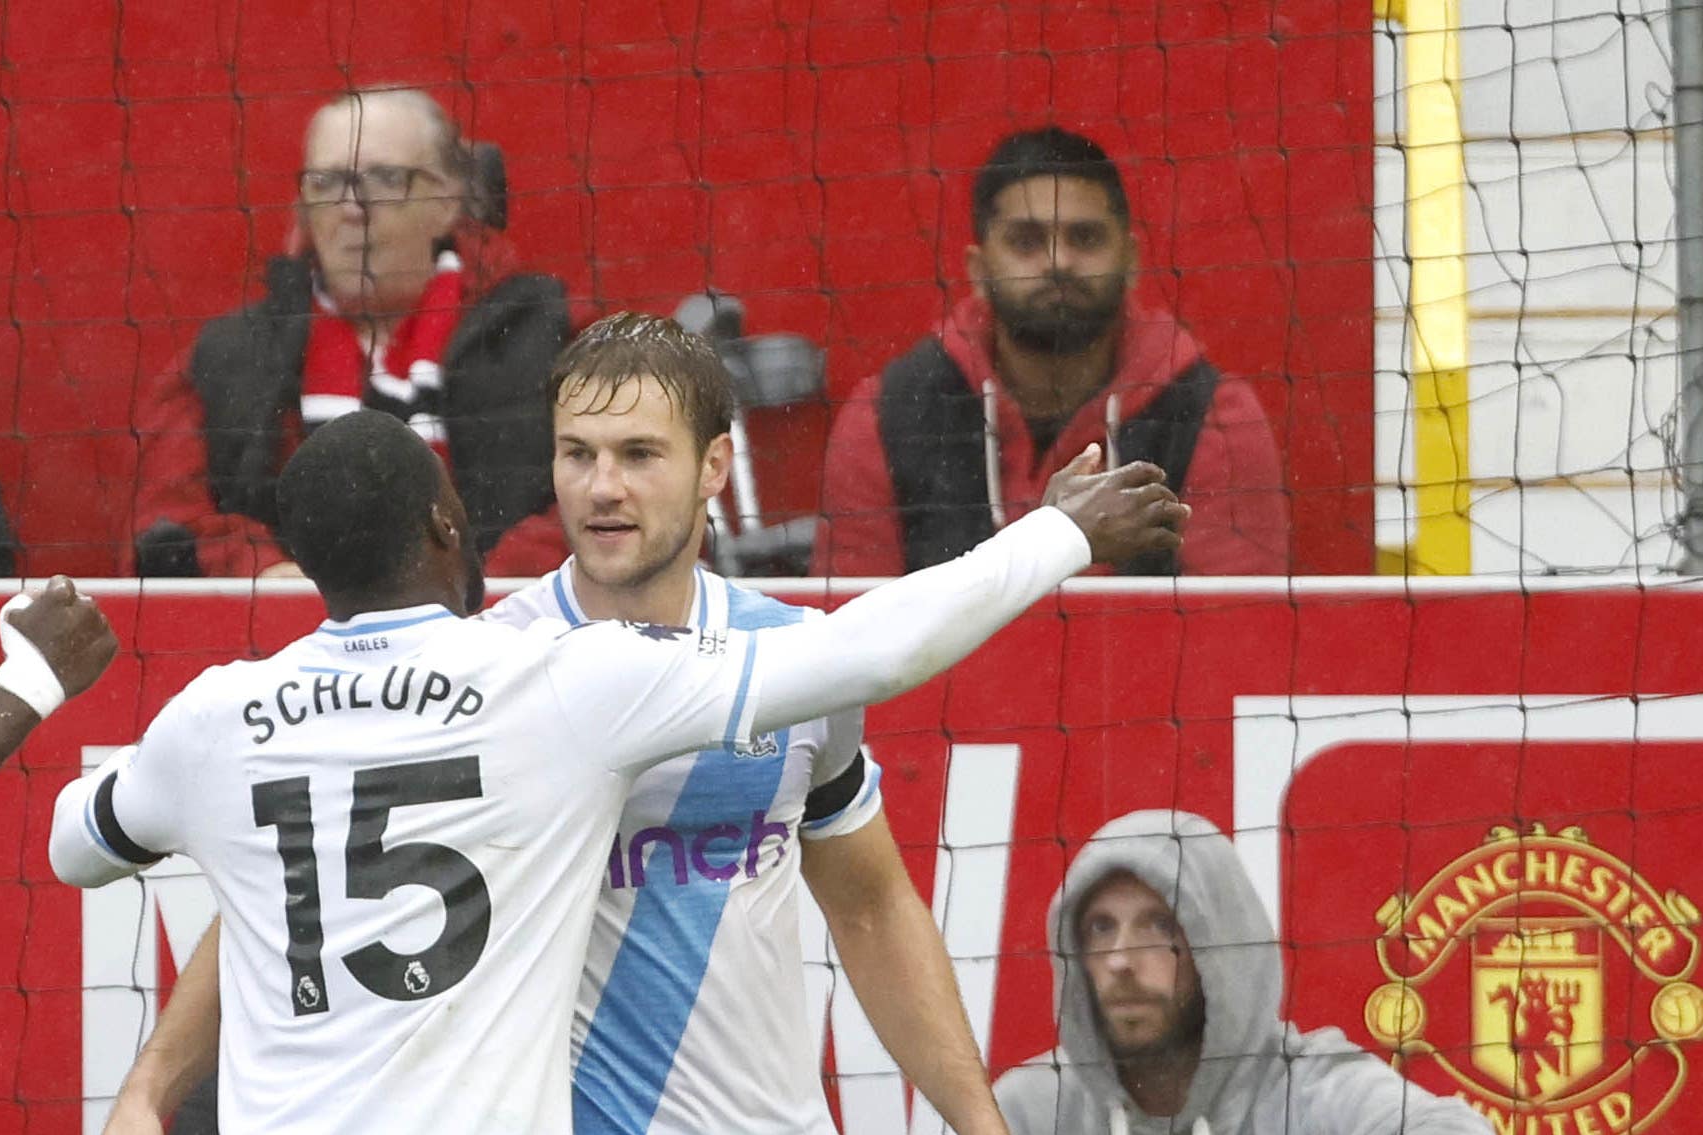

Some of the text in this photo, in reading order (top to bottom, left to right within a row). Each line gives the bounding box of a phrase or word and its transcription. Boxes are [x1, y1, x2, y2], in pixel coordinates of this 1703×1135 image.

[344, 637, 389, 653] EAGLES
[242, 665, 484, 745] SCHLUPP
[251, 755, 493, 1017] 15
[608, 809, 791, 889] inch
[1408, 850, 1676, 962] MANCHESTER
